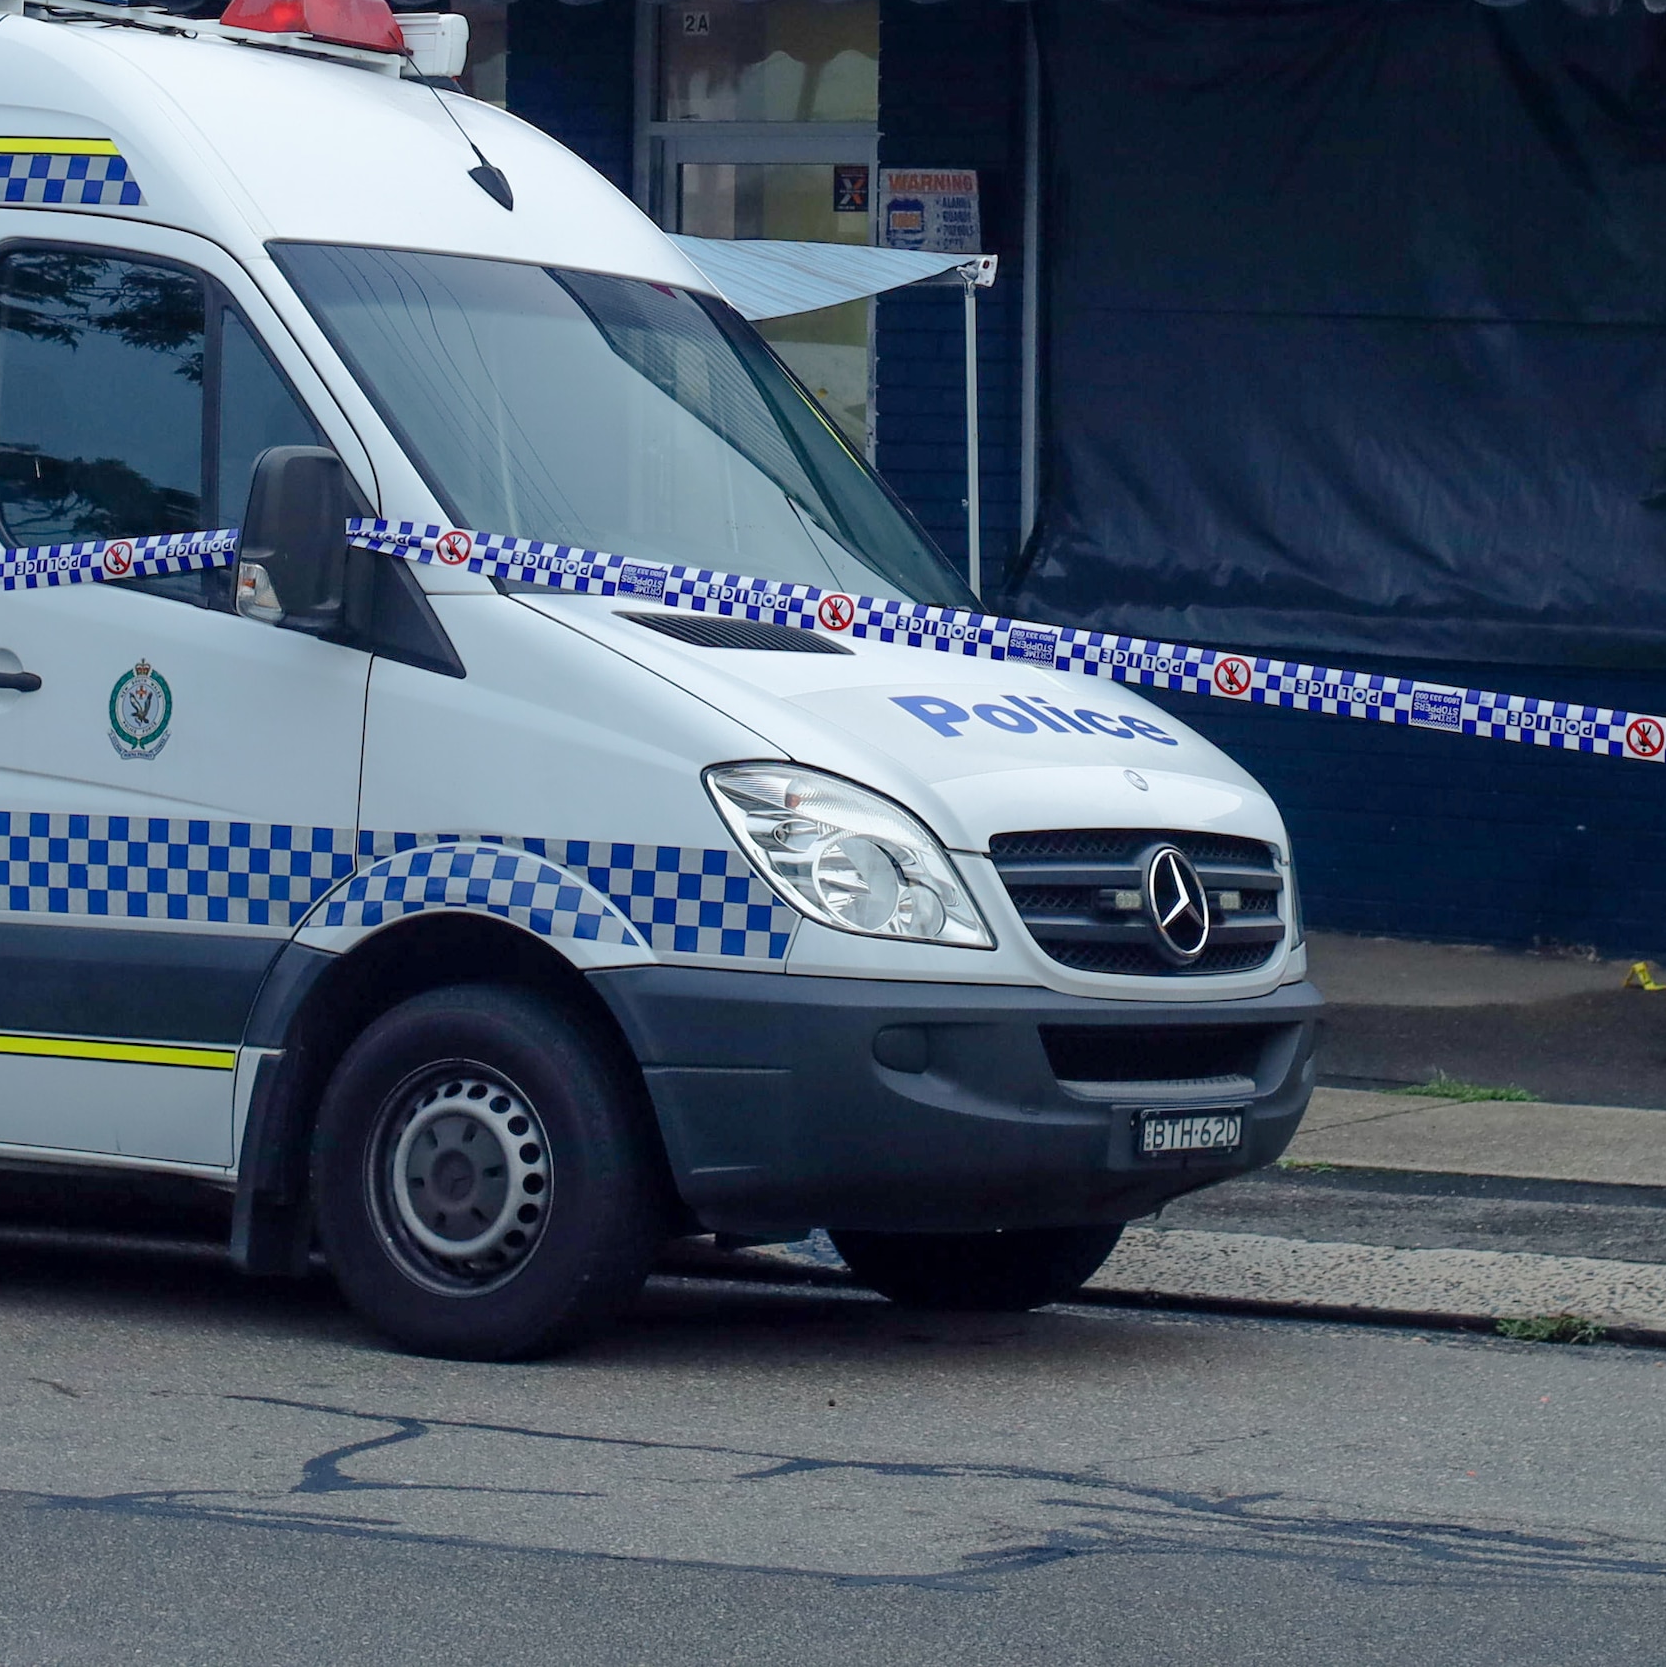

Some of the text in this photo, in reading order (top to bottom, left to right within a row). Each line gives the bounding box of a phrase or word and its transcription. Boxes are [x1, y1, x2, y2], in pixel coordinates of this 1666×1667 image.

[685, 14, 708, 32] 2A
[888, 173, 974, 192] WARNING
[15, 555, 78, 575] POLICE
[512, 551, 589, 574] POLICE
[621, 575, 663, 587] STOPPERS
[633, 586, 661, 595] CRIME
[707, 582, 789, 610] POLICE
[896, 615, 978, 640] POLICE
[1010, 640, 1053, 652] STOPPERS
[1023, 650, 1052, 660] CRIME
[1099, 646, 1185, 676] POLICE
[1295, 679, 1379, 704] POLICE
[1414, 703, 1459, 715] STOPPERS
[1428, 713, 1457, 723] CRIME
[889, 695, 1179, 748] Police
[1508, 712, 1595, 737] POLICE
